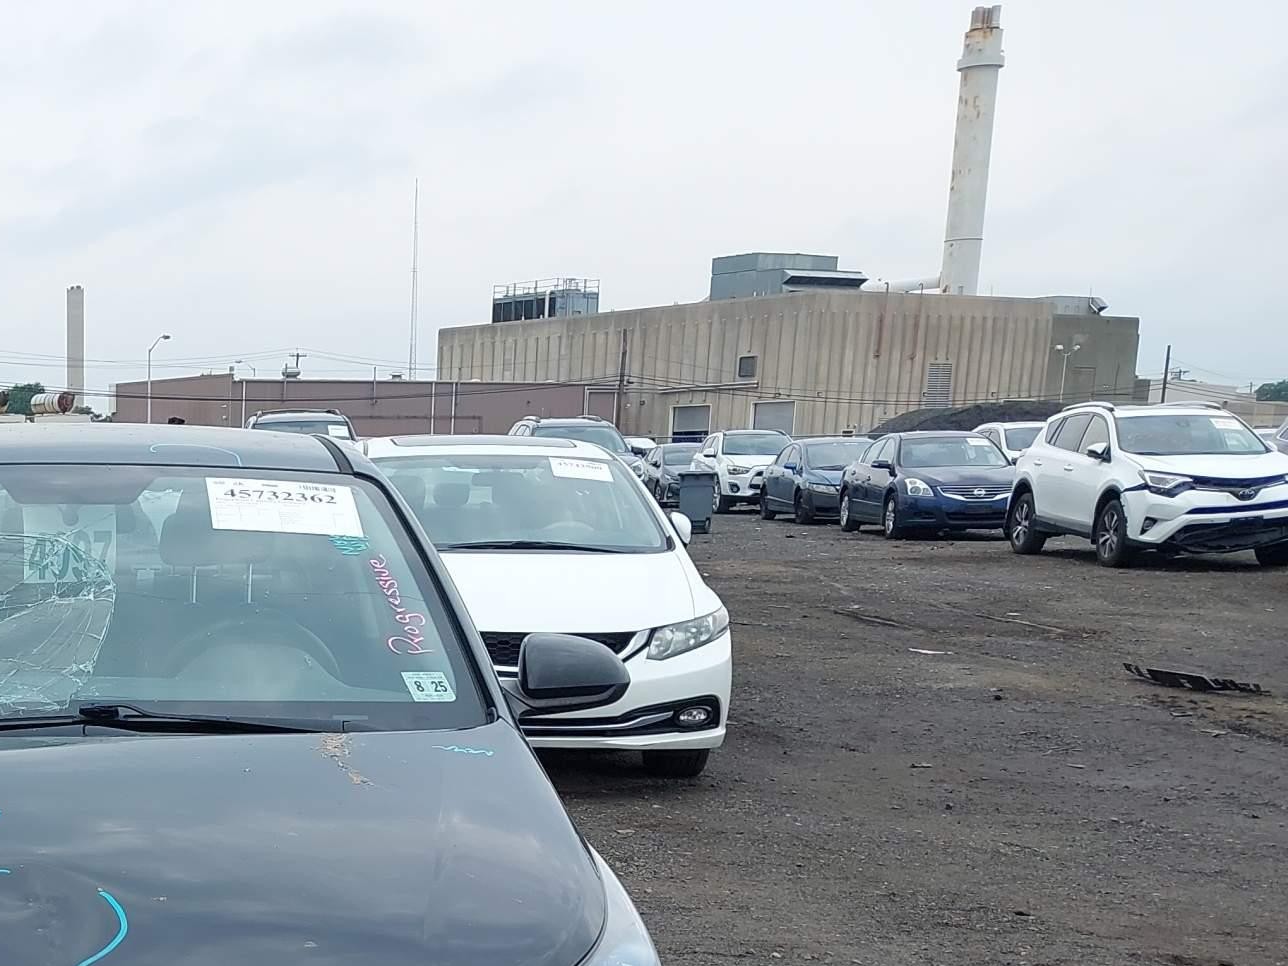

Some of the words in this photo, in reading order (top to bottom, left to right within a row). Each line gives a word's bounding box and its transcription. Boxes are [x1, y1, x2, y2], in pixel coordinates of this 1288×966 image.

[223, 488, 337, 504] 45732362
[369, 553, 434, 655] Progressive
[414, 680, 425, 692] 8
[431, 680, 448, 692] 25
